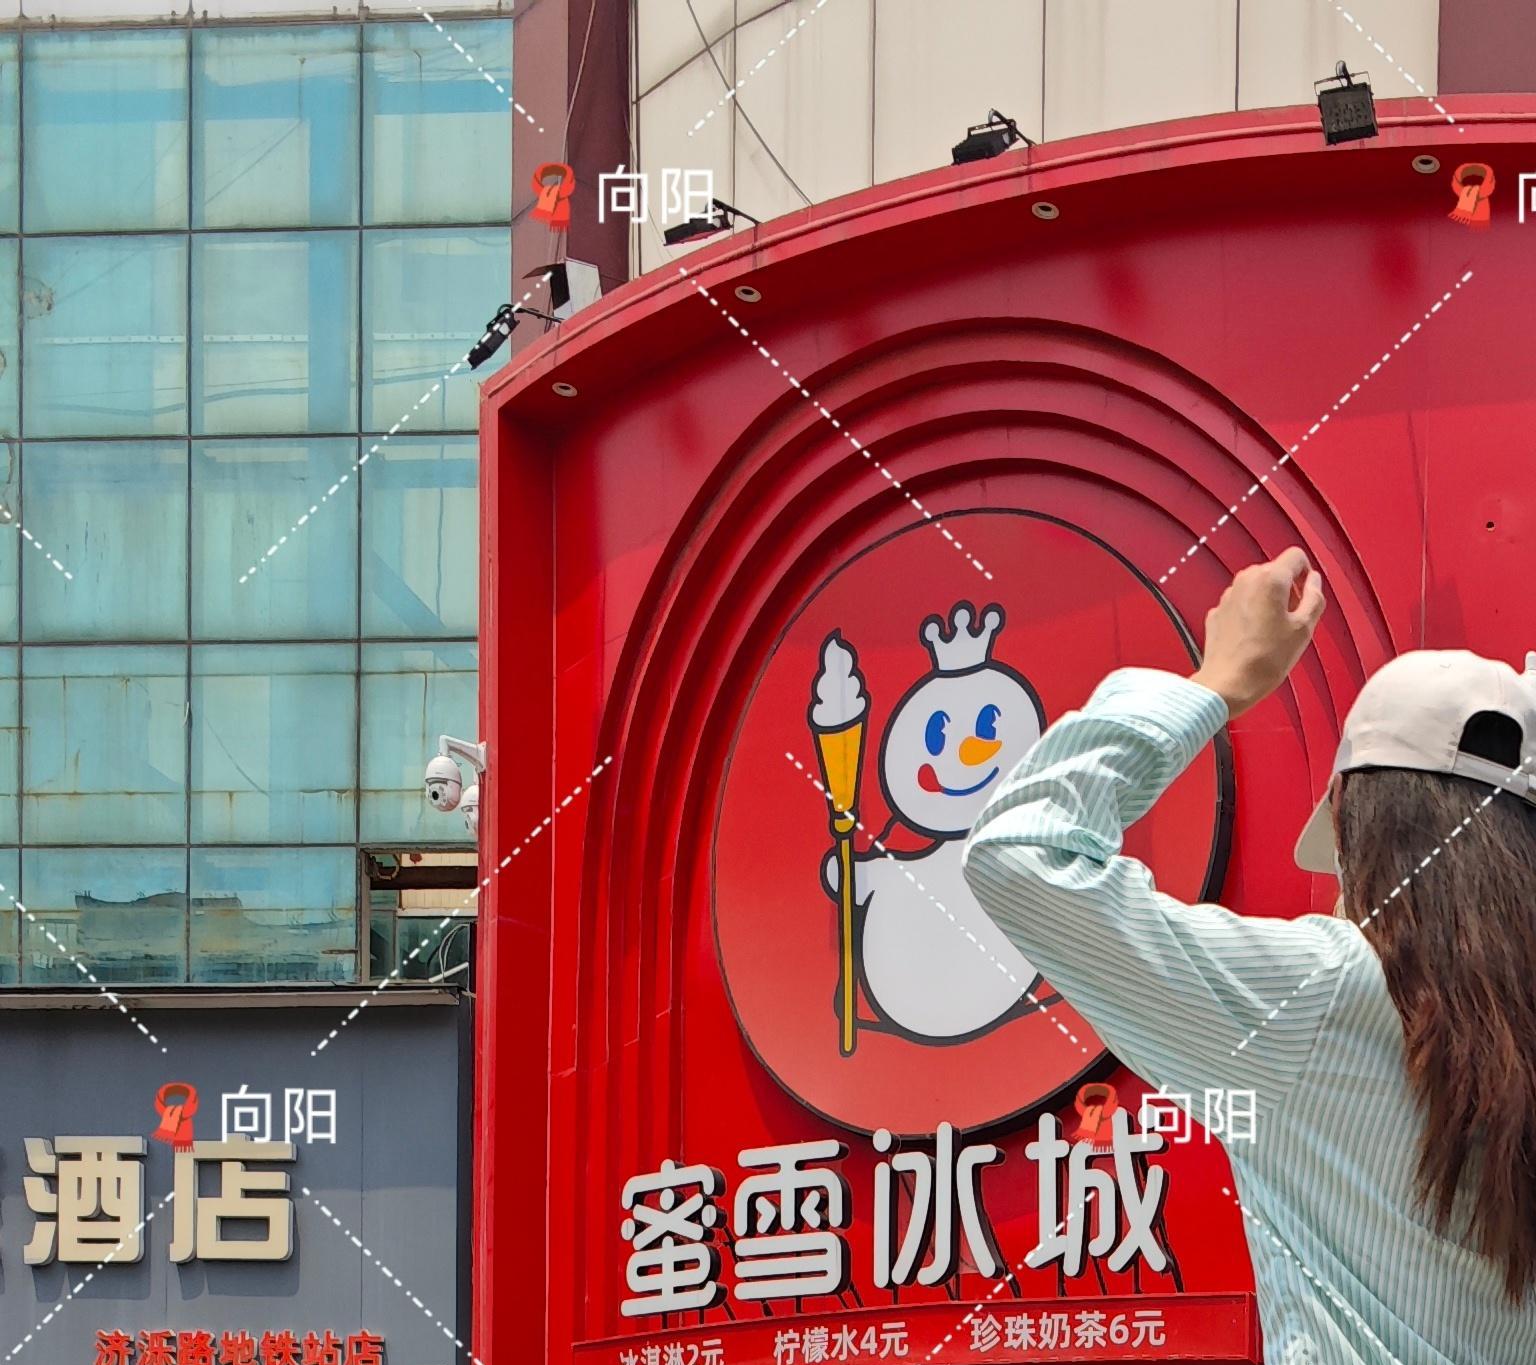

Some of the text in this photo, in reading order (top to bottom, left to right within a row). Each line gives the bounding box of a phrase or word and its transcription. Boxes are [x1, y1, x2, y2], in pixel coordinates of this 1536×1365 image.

[23, 1134, 298, 1266] 酒店
[620, 1107, 1166, 1318] 蜜雪冰城
[970, 1310, 1166, 1353] 珍珠奶茶6元
